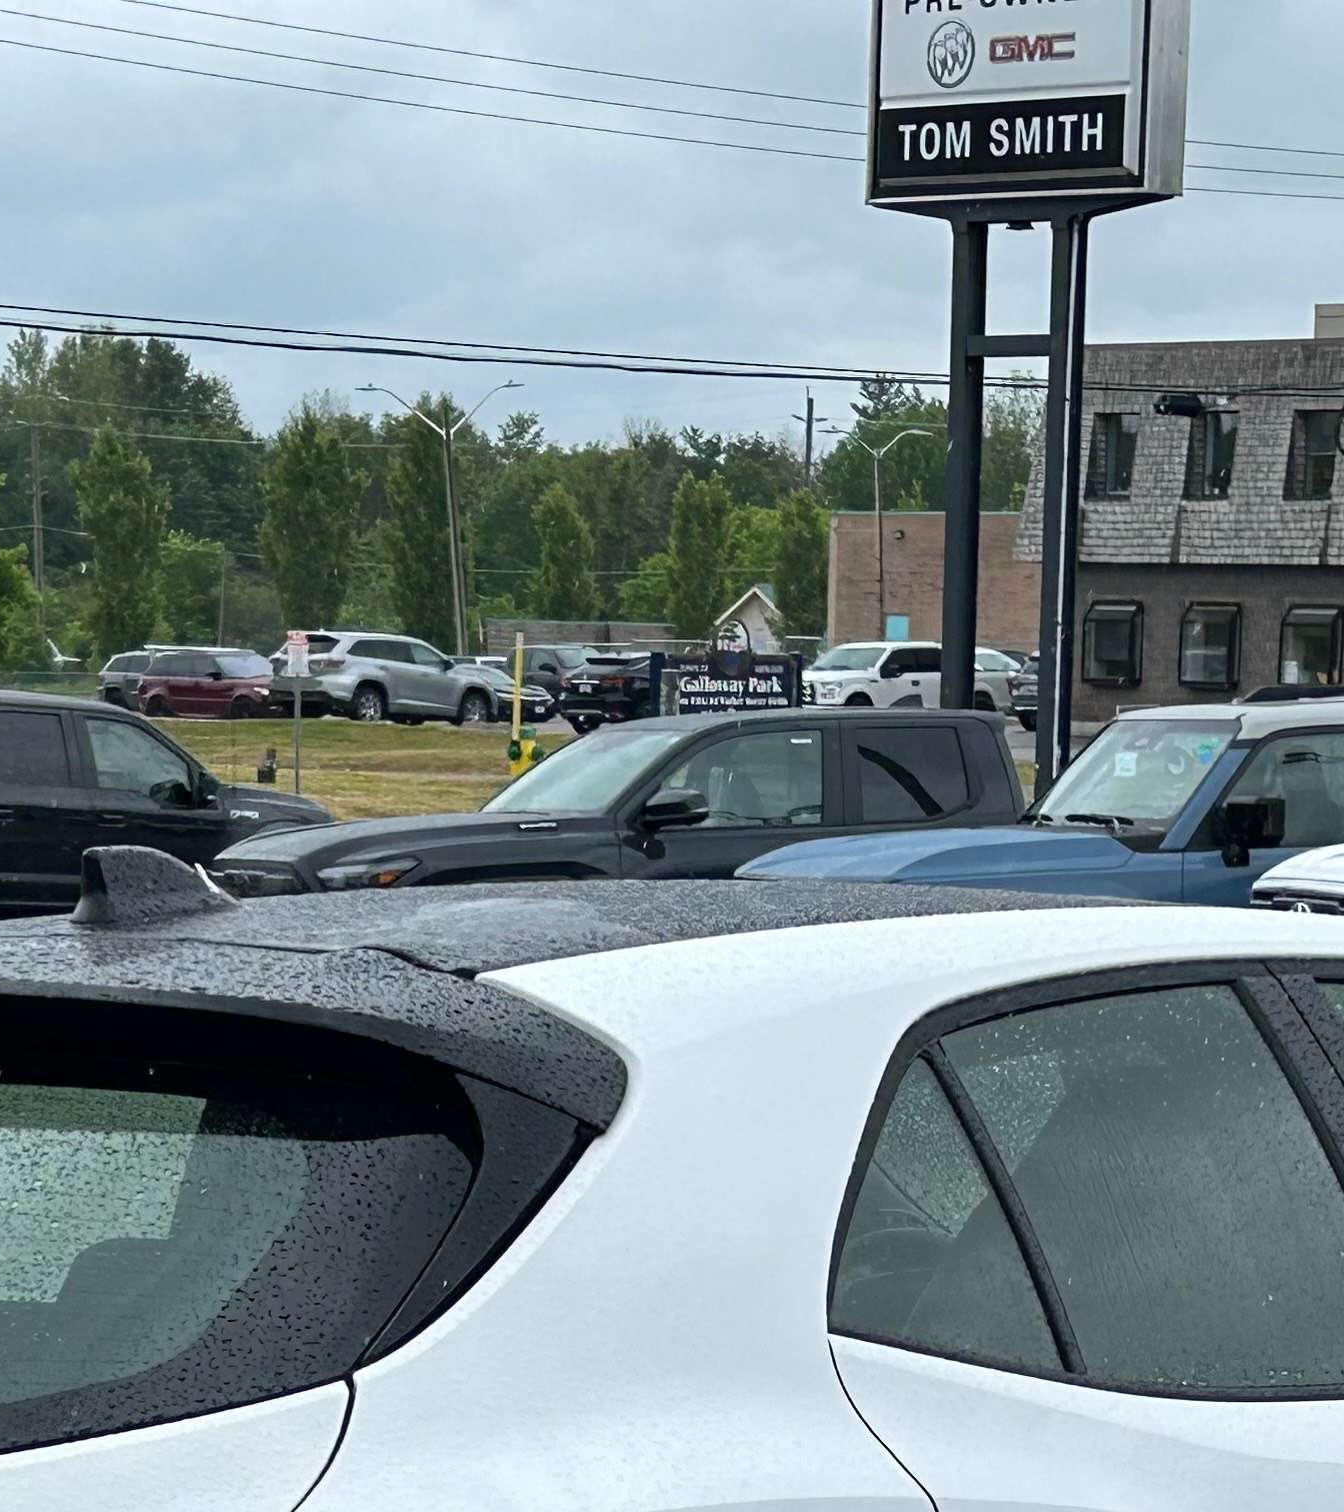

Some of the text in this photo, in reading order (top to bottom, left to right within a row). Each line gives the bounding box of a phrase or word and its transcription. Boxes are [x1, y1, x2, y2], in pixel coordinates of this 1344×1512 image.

[989, 32, 1076, 64] GMC
[898, 112, 1103, 161] TOM SMITH
[679, 675, 782, 697] Galloway Park
